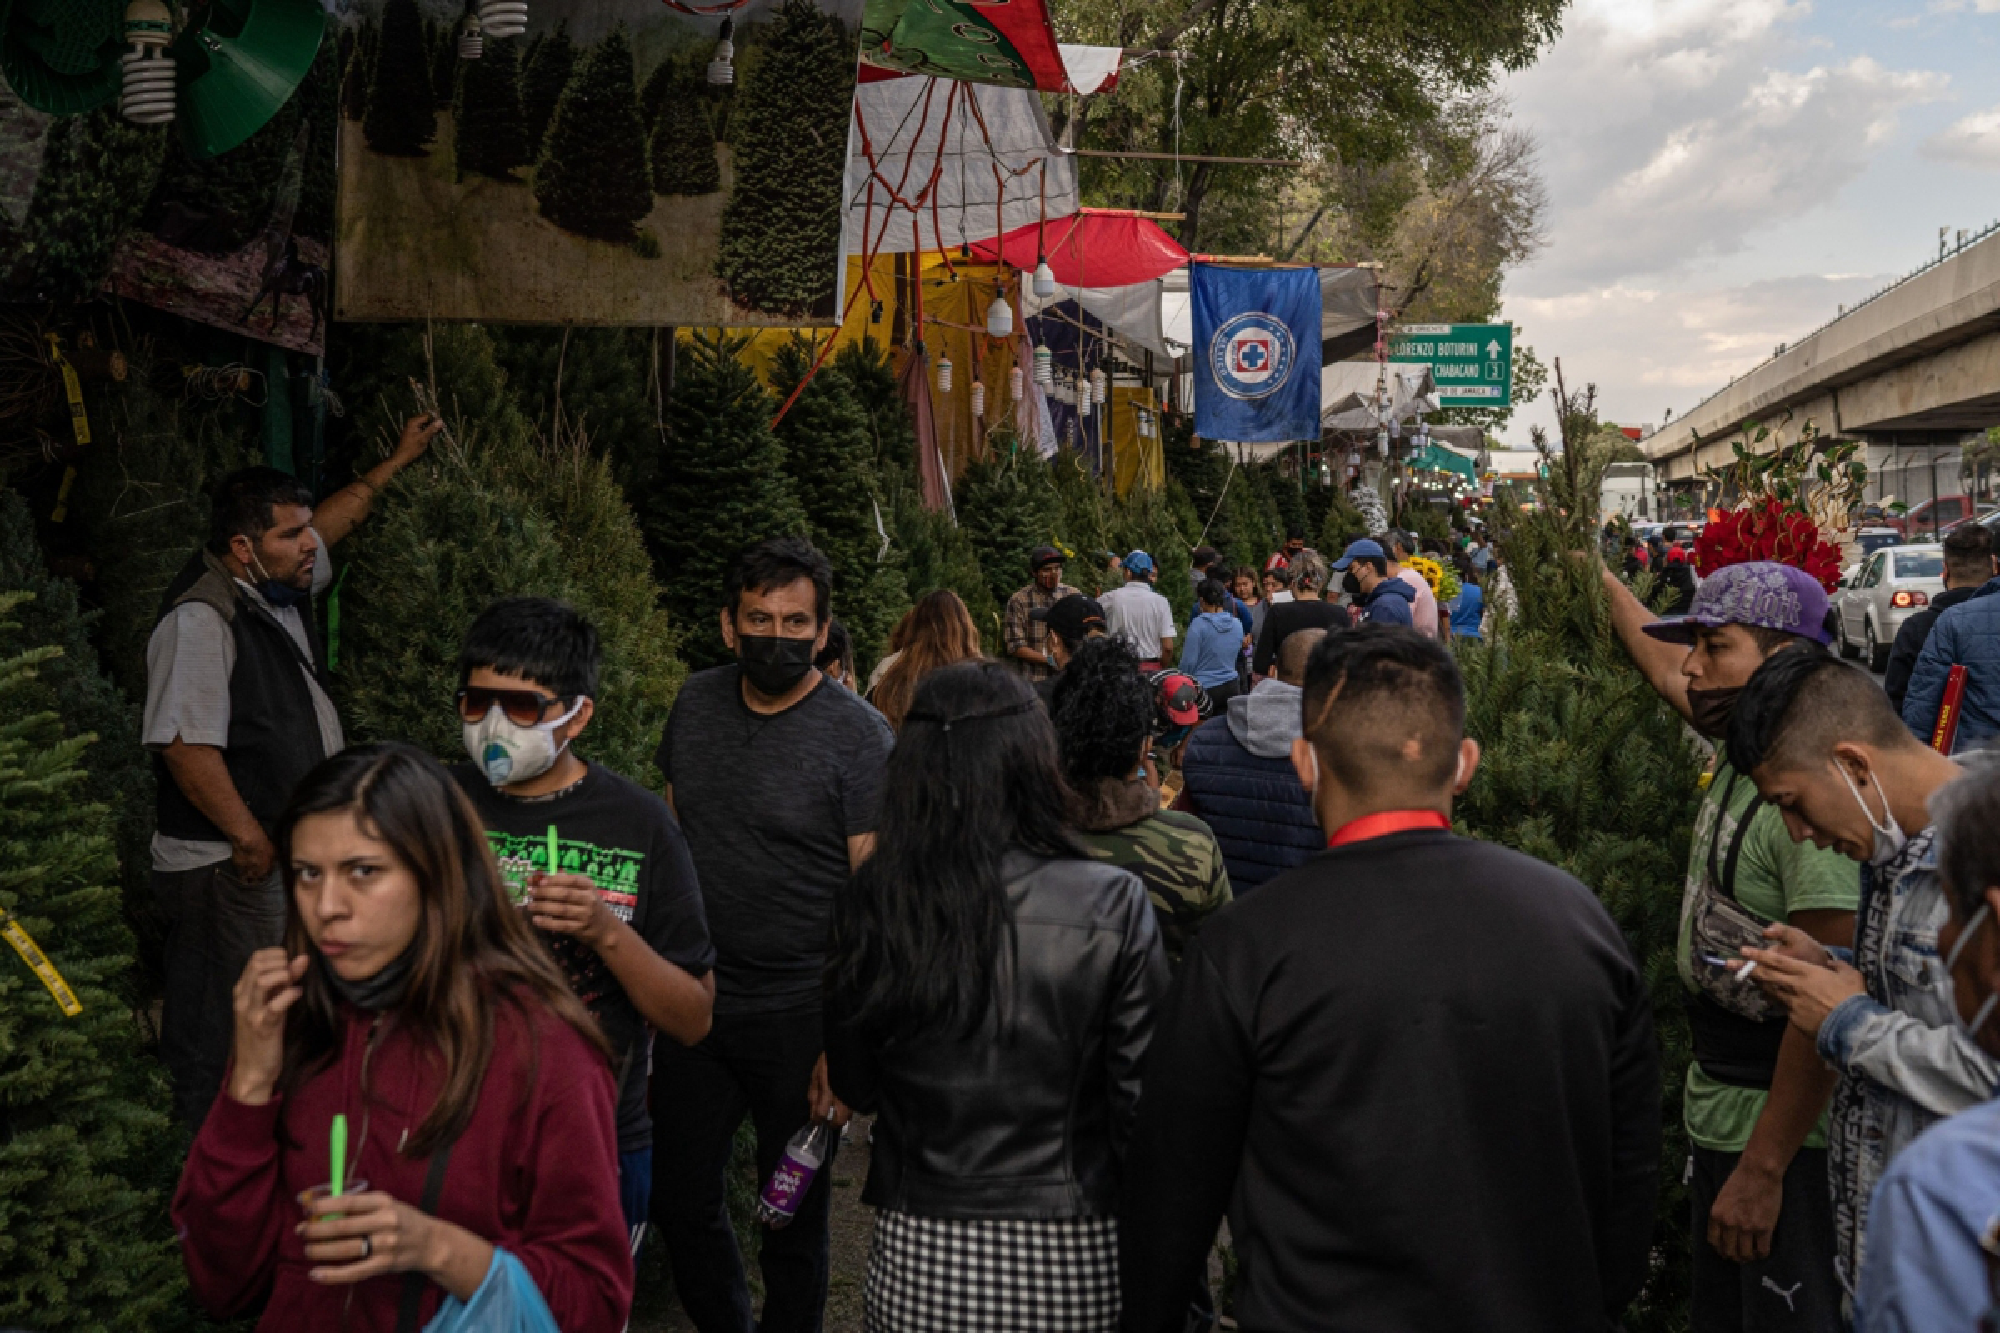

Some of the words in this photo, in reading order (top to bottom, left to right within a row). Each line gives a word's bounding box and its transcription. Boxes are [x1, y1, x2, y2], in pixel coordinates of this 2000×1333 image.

[1395, 342, 1434, 357] LORENZO
[1437, 342, 1478, 357] BOTURINI
[1435, 363, 1479, 378] CHABACANO
